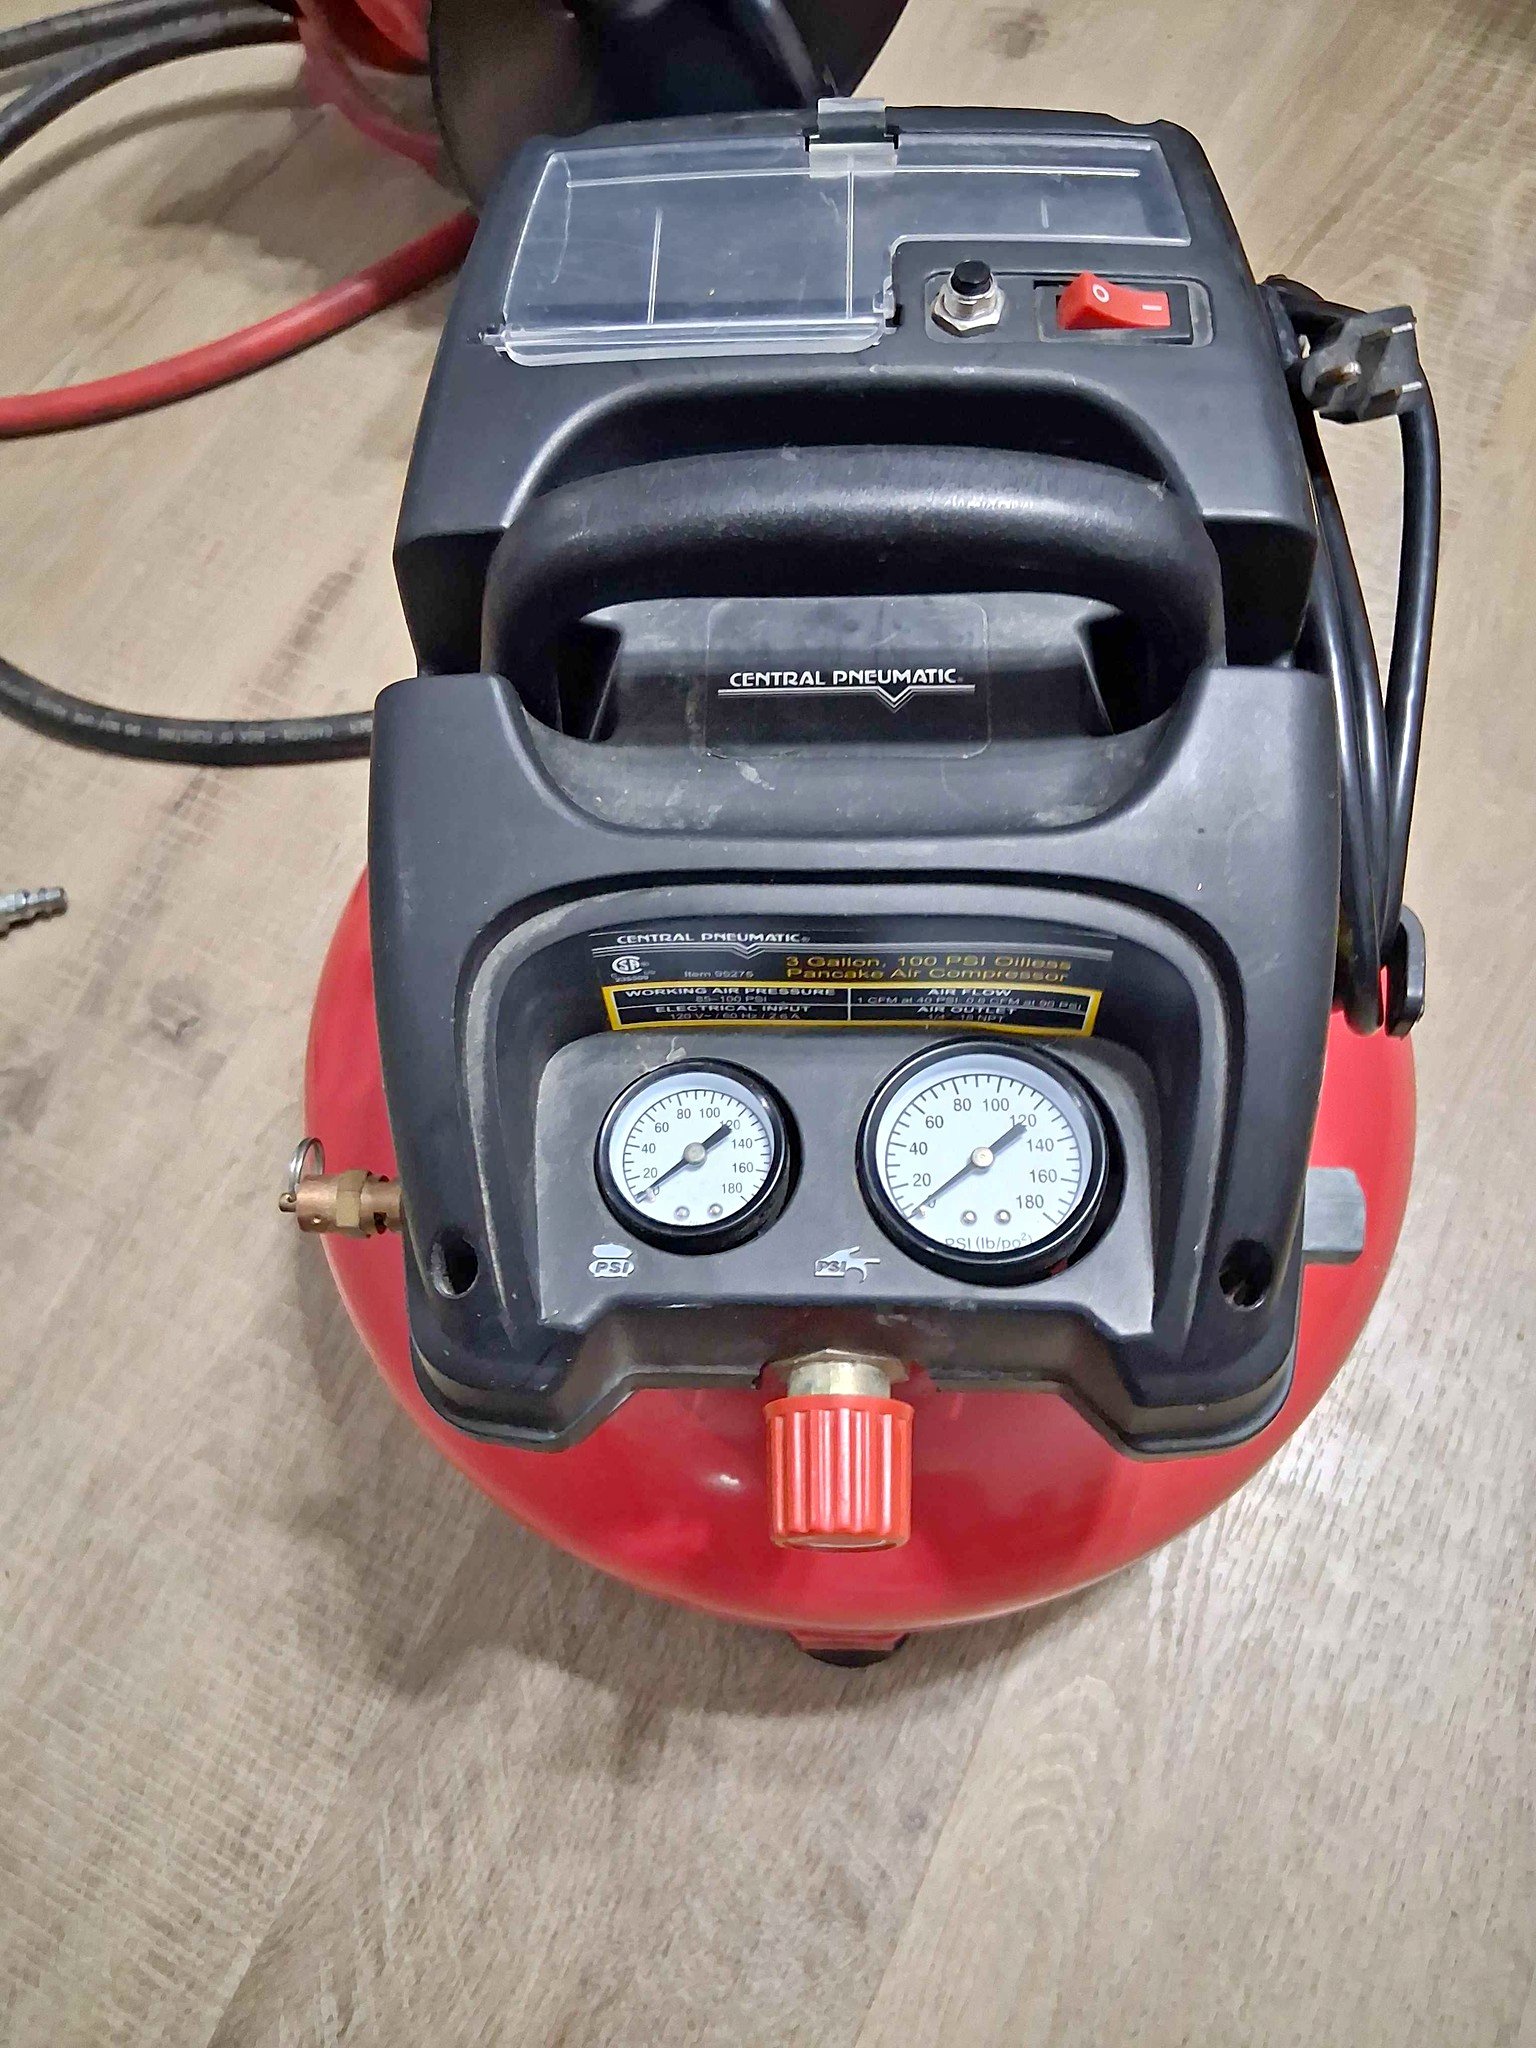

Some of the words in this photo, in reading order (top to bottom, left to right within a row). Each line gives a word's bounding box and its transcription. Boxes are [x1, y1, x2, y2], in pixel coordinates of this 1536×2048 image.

[729, 670, 826, 688] CENTRAL
[832, 667, 957, 687] PNEUMATIC
[617, 932, 694, 945] CENTRAL
[785, 956, 799, 967] 3
[806, 955, 887, 969] Gallon,
[897, 955, 938, 967] 100
[946, 955, 986, 967] PSI
[994, 956, 1072, 971] Oilless
[684, 970, 712, 979] Item
[785, 967, 884, 980] Pancake
[890, 967, 922, 980] Air
[929, 968, 1069, 983] Compressor
[625, 987, 708, 998] WORKING
[711, 986, 740, 995] AIR
[744, 987, 836, 997] PRESSURE
[927, 988, 956, 996] AIR
[961, 988, 1012, 997] FLOW
[745, 995, 767, 1004] PSI
[867, 996, 898, 1005] CFM
[916, 996, 933, 1005] 40
[655, 1005, 758, 1014] ELECTRICAL
[761, 1005, 812, 1013] INPUT
[670, 1012, 692, 1020] 120
[949, 1006, 1018, 1015] OUTLET
[953, 1097, 972, 1112] 80
[982, 1097, 1010, 1112] 100
[676, 1108, 692, 1120] 80
[699, 1107, 721, 1119] 100
[925, 1114, 944, 1129] 60
[1010, 1113, 1037, 1127] 120
[654, 1121, 670, 1133] 60
[641, 1142, 656, 1154] 40
[731, 1138, 754, 1150] 140
[909, 1141, 928, 1156] 40
[1026, 1138, 1055, 1152] 140
[643, 1167, 659, 1179] 20
[732, 1161, 754, 1174] 160
[913, 1172, 932, 1187] 20
[1028, 1168, 1058, 1183] 160
[721, 1182, 743, 1194] 180
[1015, 1194, 1045, 1209] 180
[595, 1261, 630, 1274] PSI
[816, 1260, 848, 1273] PSI
